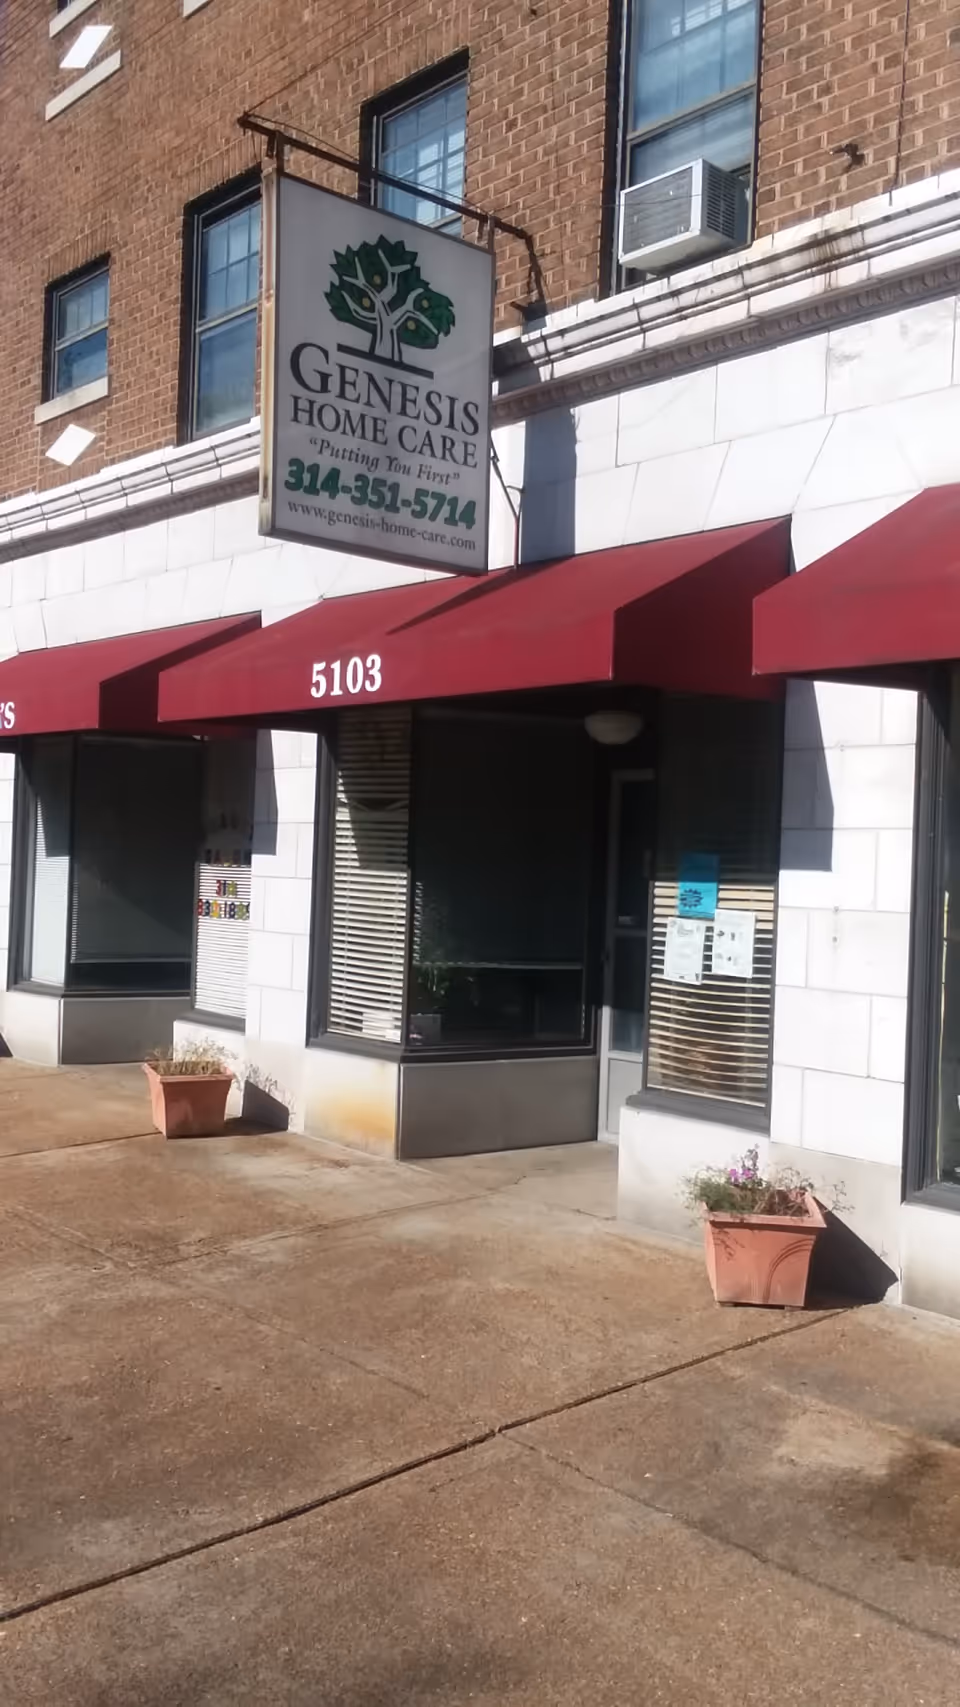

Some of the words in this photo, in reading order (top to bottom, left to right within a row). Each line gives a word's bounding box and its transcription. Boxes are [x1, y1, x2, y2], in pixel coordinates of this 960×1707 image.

[290, 342, 480, 437] GENESIS
[290, 394, 389, 446] HOME
[397, 424, 478, 469] CARE
[284, 457, 477, 530] 314-351-5714
[385, 454, 412, 476] You
[287, 501, 477, 551] www.genesis-home-care.com
[310, 653, 382, 698] 5103
